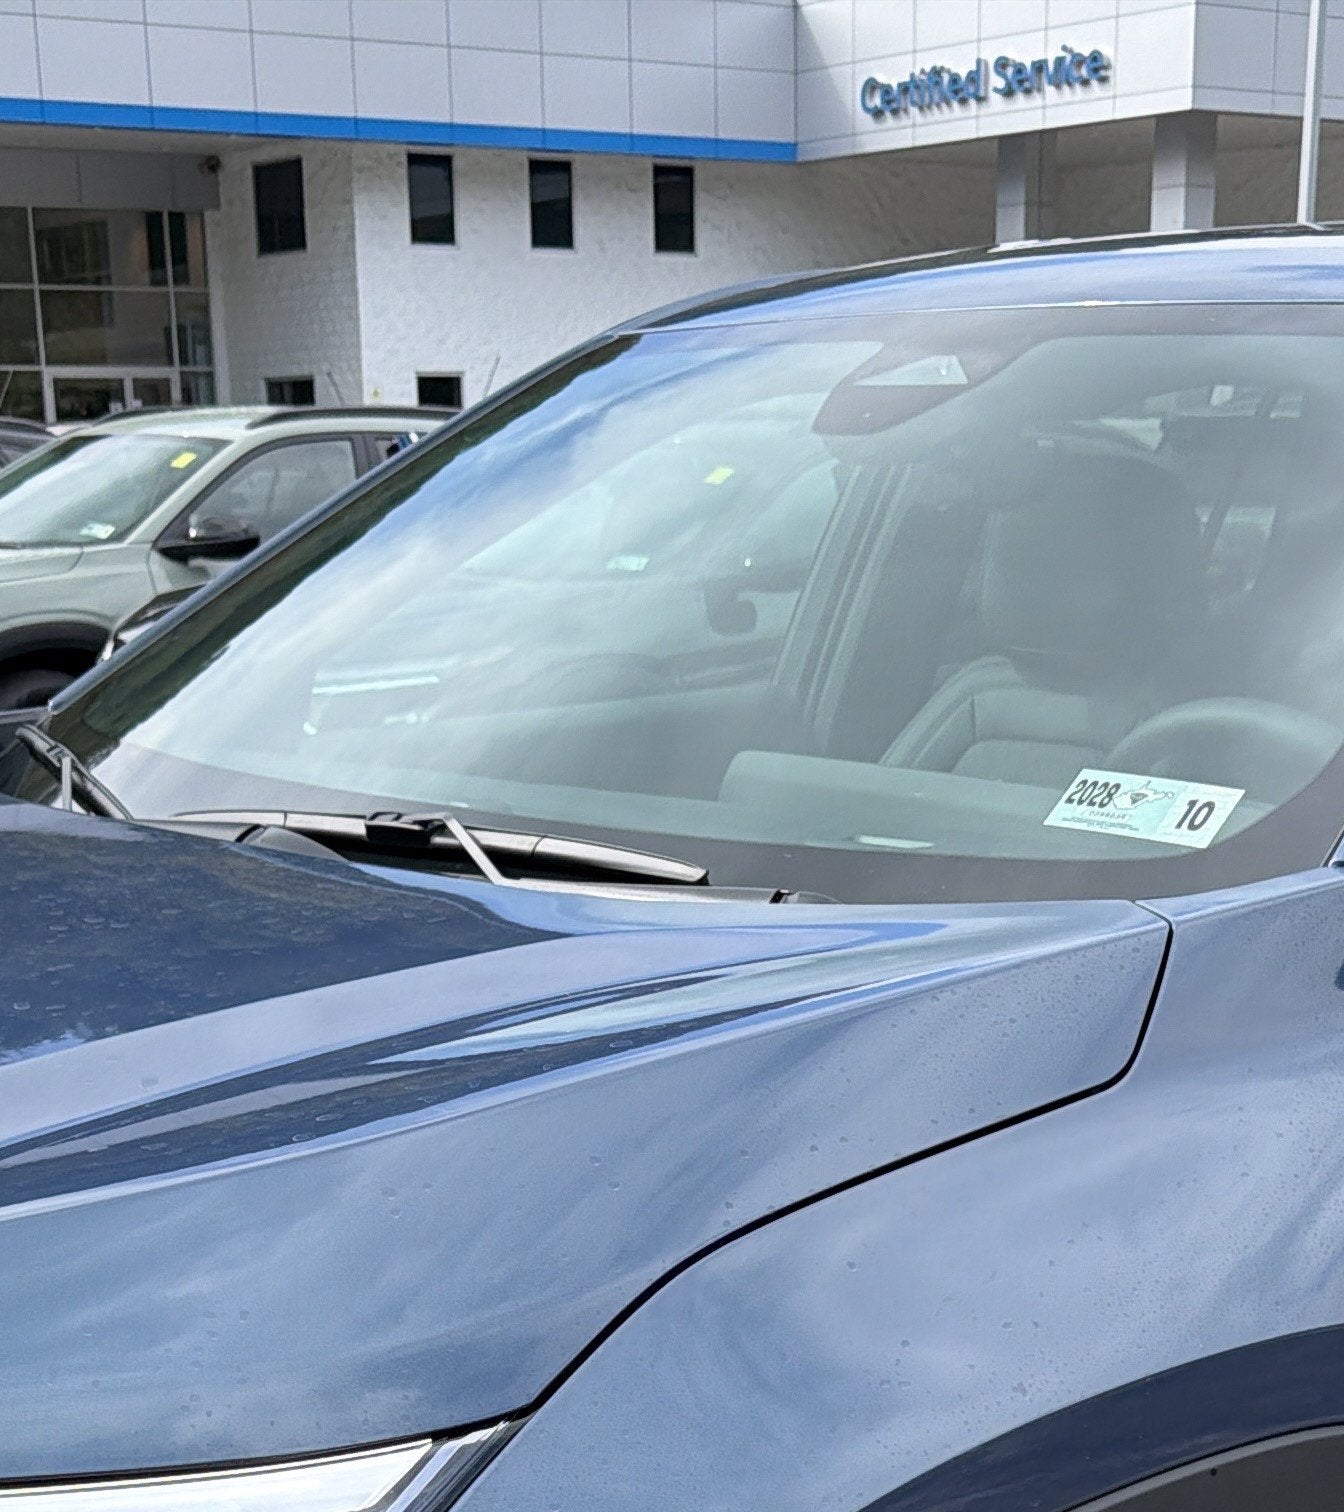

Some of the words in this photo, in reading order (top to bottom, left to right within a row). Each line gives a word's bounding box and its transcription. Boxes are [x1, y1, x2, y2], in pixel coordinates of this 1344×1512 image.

[861, 57, 987, 116] Certified
[992, 45, 1110, 98] Service
[1064, 779, 1121, 808] 2028
[1175, 799, 1215, 831] 10
